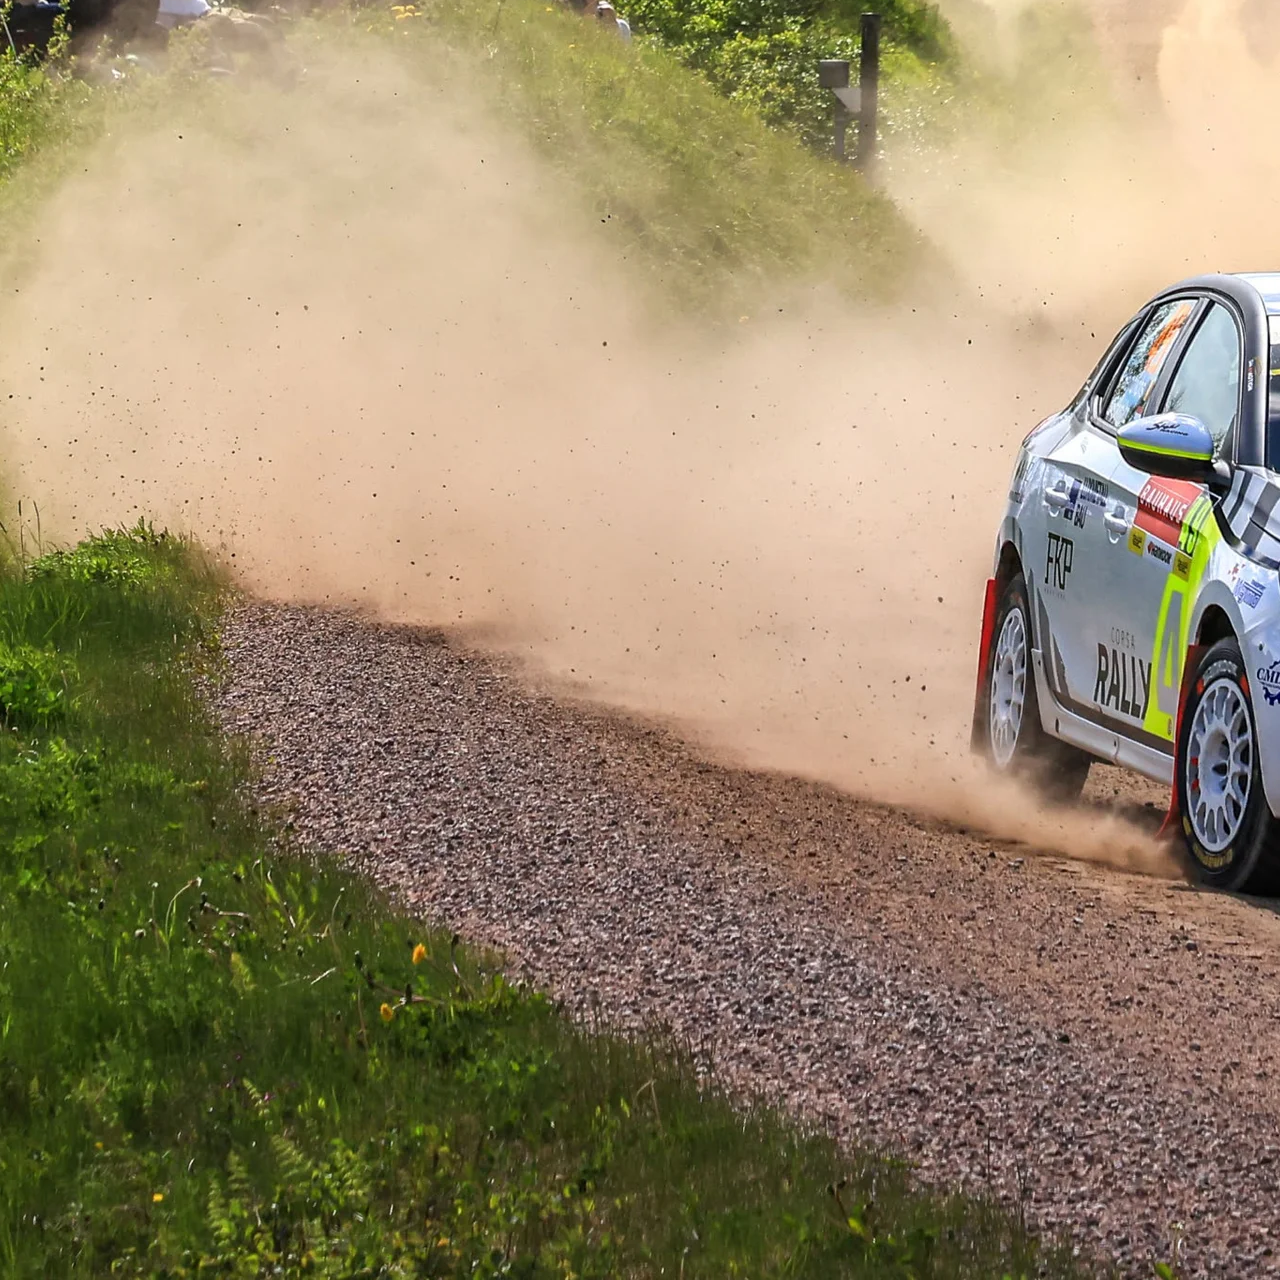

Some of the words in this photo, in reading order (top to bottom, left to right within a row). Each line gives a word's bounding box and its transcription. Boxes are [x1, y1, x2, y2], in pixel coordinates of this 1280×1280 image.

[1140, 484, 1189, 524] BAUHAUS
[1044, 532, 1074, 590] FKP
[1094, 642, 1152, 721] RALLY
